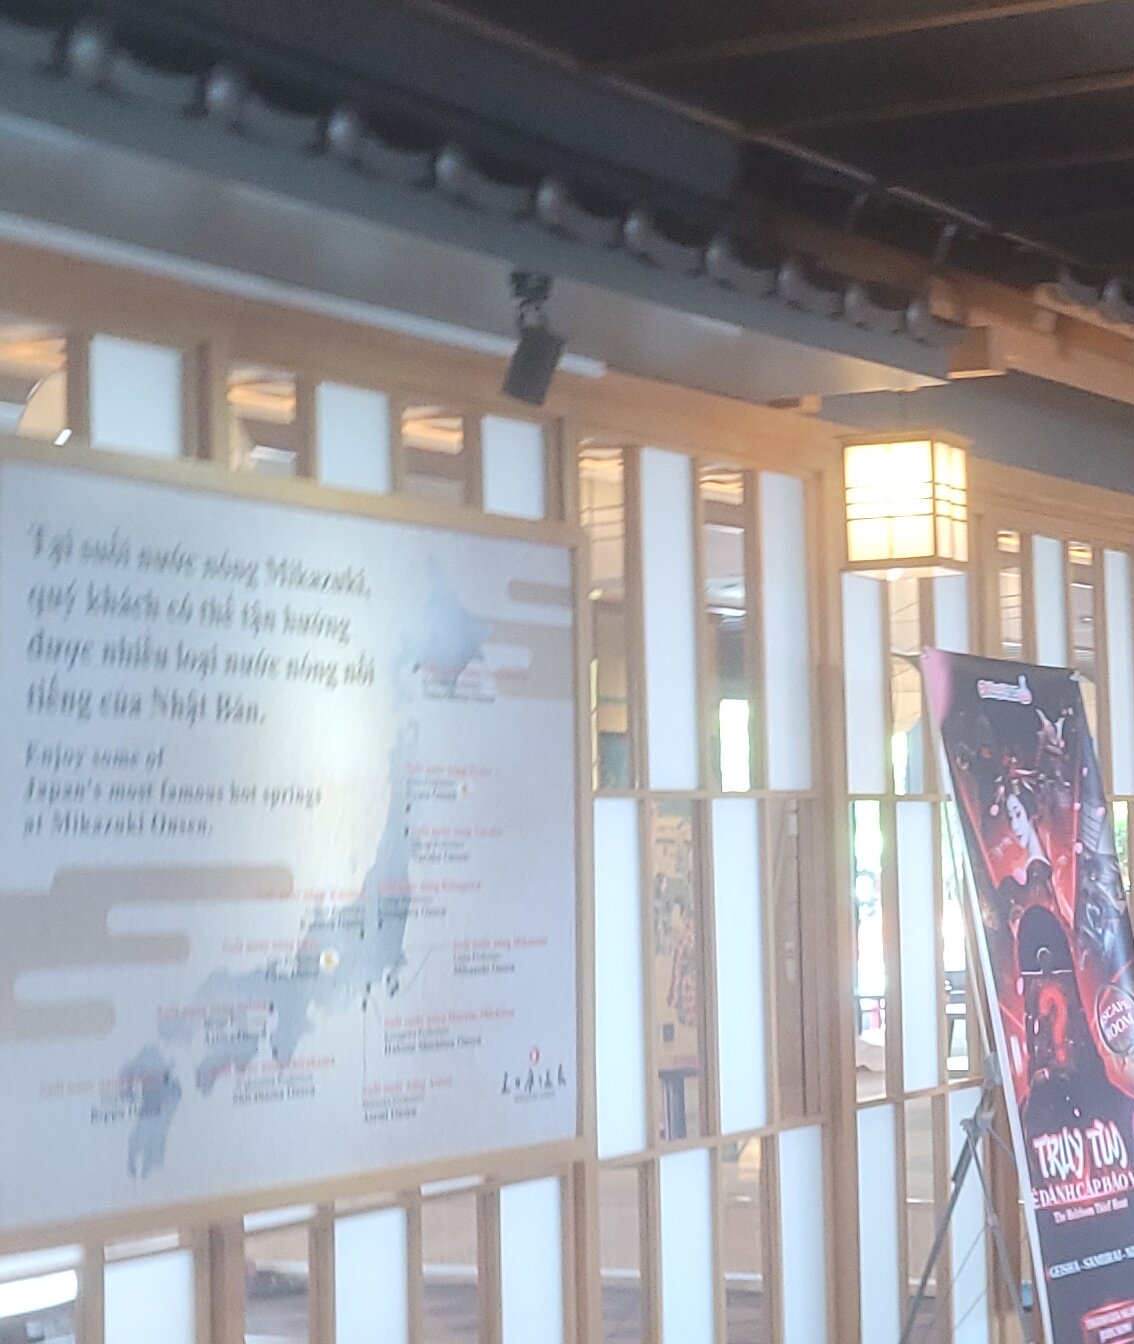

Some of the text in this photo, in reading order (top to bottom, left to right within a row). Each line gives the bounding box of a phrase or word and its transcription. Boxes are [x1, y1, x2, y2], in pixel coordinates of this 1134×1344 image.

[27, 579, 77, 622] quý
[86, 581, 160, 622] khách
[166, 592, 194, 625] có
[200, 588, 234, 629] thể
[242, 599, 277, 638] tận
[27, 628, 90, 672] được
[102, 630, 168, 671] nhiều
[176, 640, 218, 681] loại
[224, 646, 280, 681] nước
[286, 650, 338, 690] nóng
[27, 670, 92, 725] tiếng
[100, 688, 143, 720] của
[151, 687, 207, 730] Nhật
[25, 742, 165, 771] Enjoy some of
[27, 776, 322, 810] Japan's most famous hot springs
[24, 812, 44, 836] at
[54, 810, 145, 836] Mikazuki
[1032, 1125, 1084, 1181] TRUY
